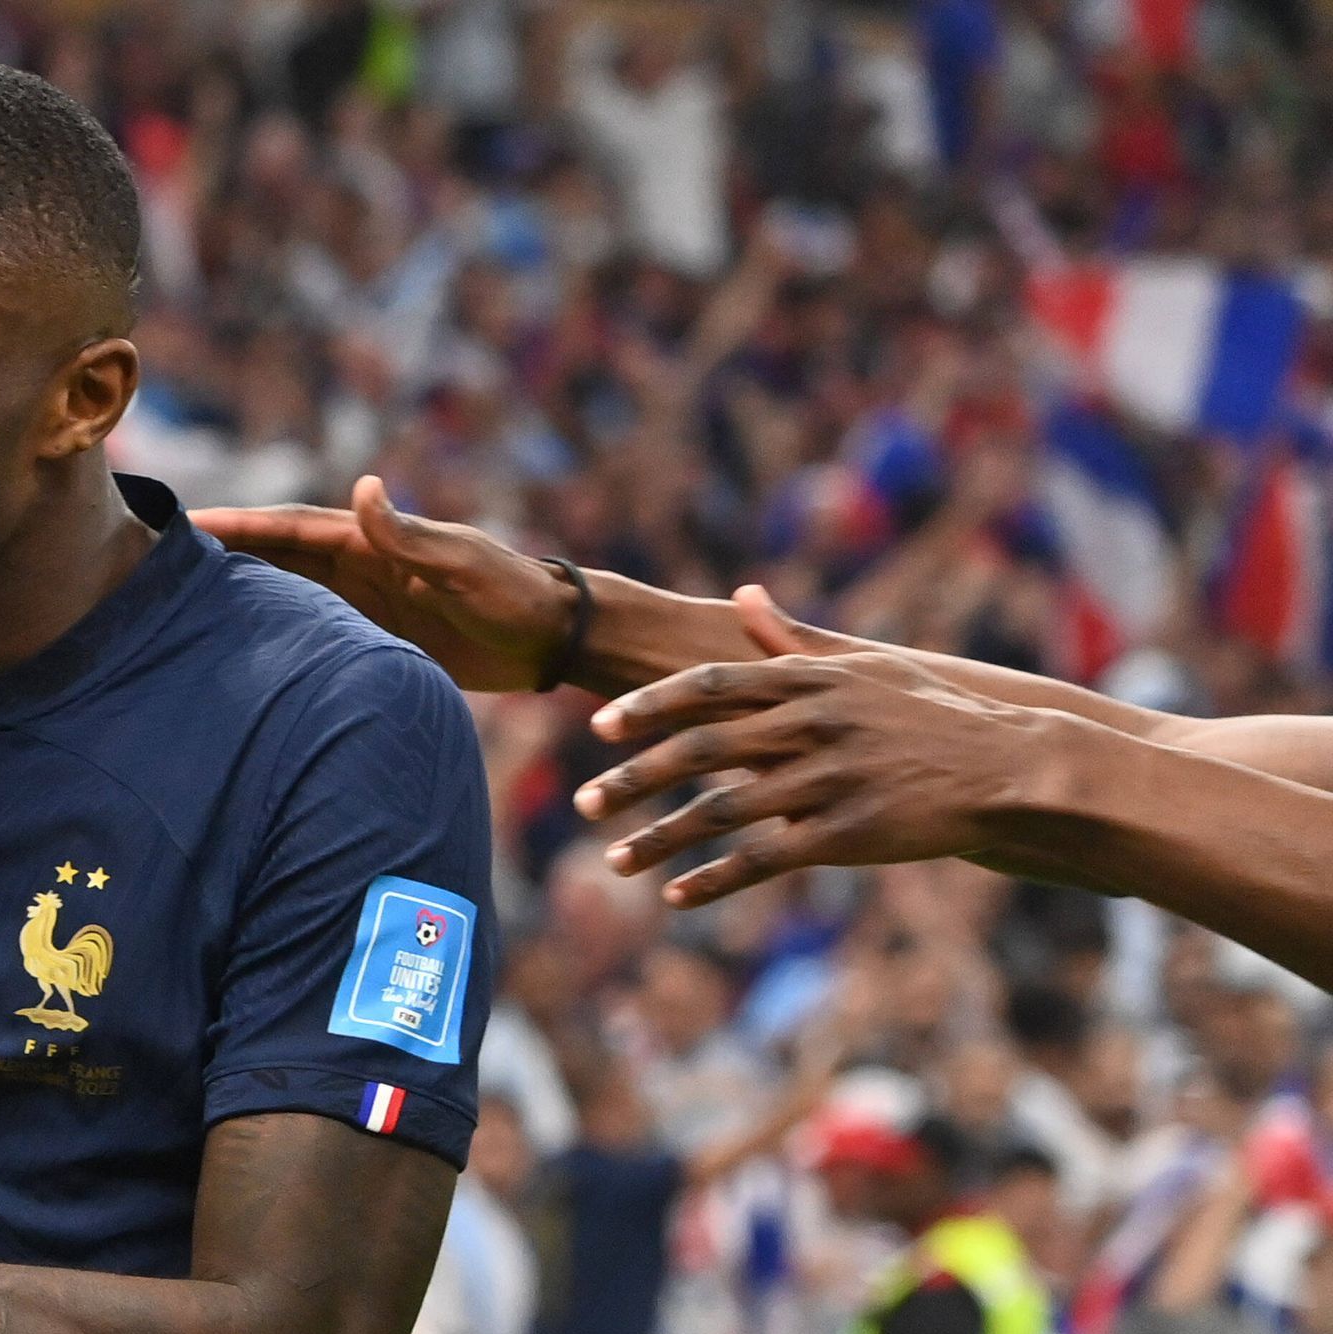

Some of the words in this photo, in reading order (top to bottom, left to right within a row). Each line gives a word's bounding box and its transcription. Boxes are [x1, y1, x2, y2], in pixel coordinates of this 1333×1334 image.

[394, 950, 445, 976] FOOTBALL
[389, 965, 442, 996] UNITES
[398, 1011, 417, 1024] FIFA
